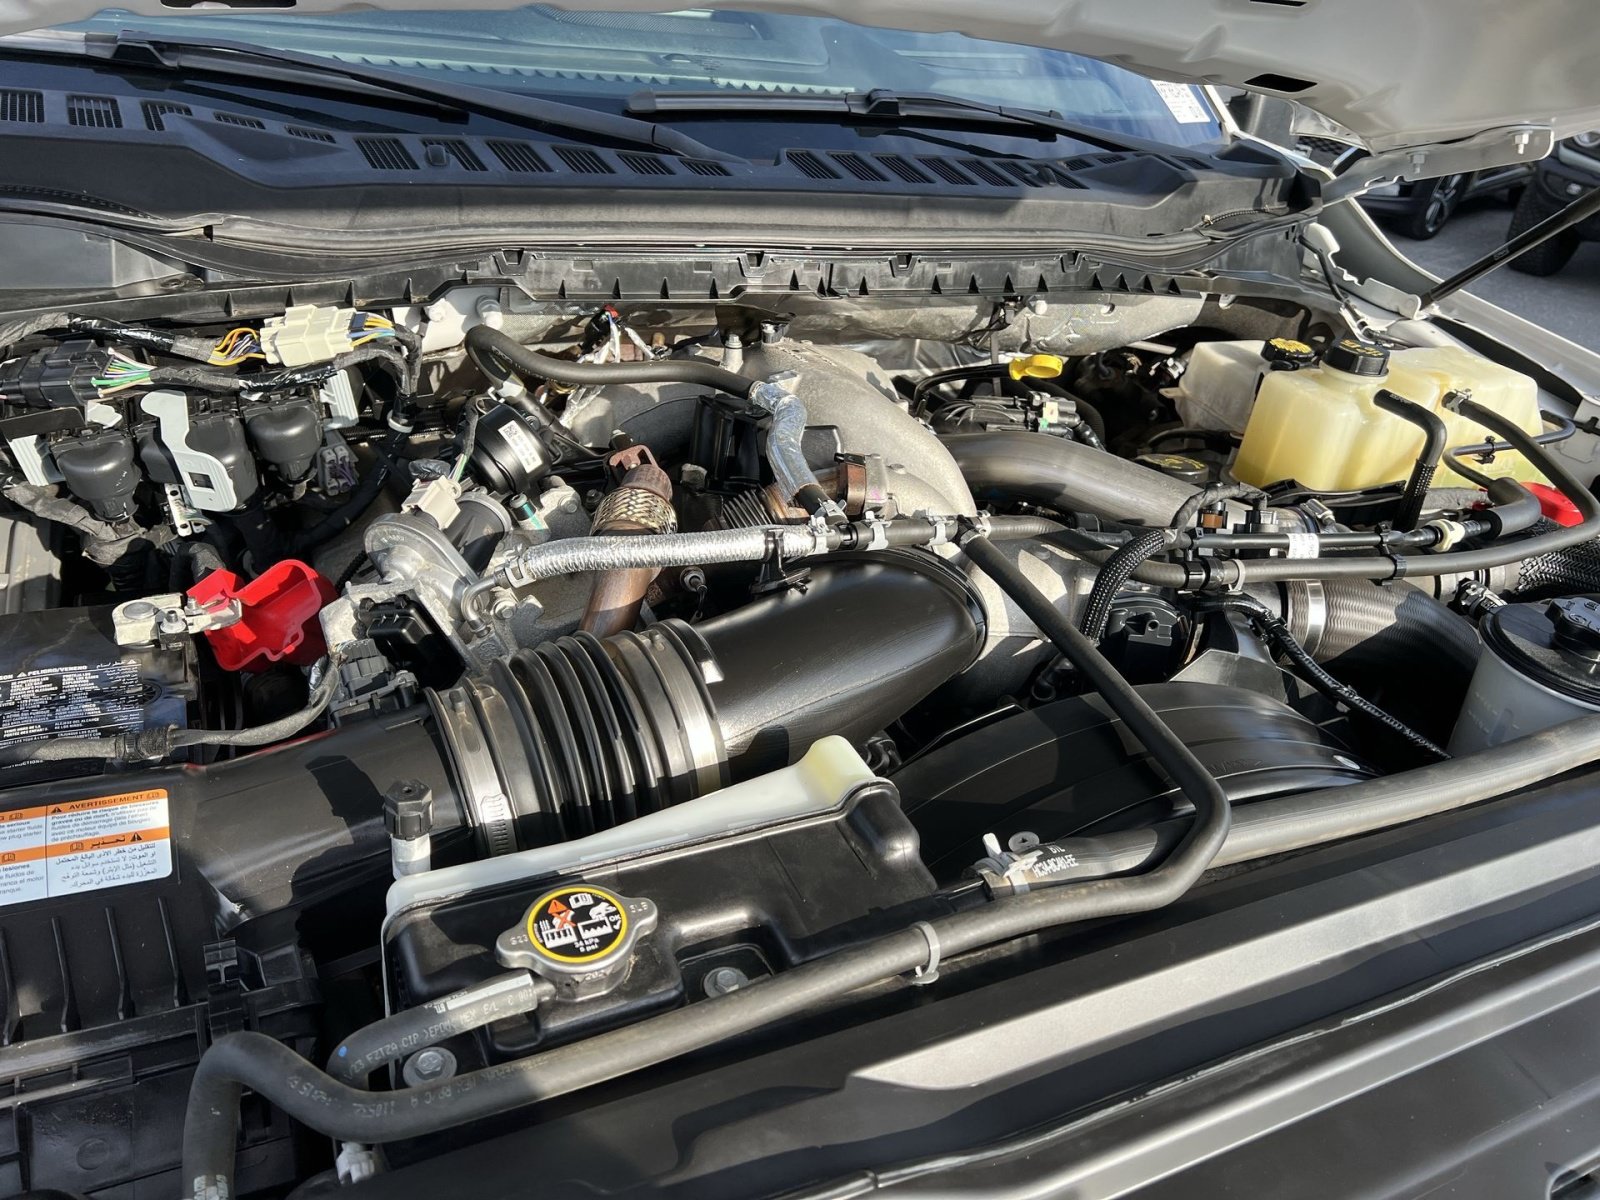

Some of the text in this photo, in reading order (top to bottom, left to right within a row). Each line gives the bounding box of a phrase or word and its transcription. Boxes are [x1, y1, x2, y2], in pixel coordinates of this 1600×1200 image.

[69, 794, 144, 810] AVERTISSEMENT
[609, 914, 622, 922] OK
[584, 937, 600, 946] kPa
